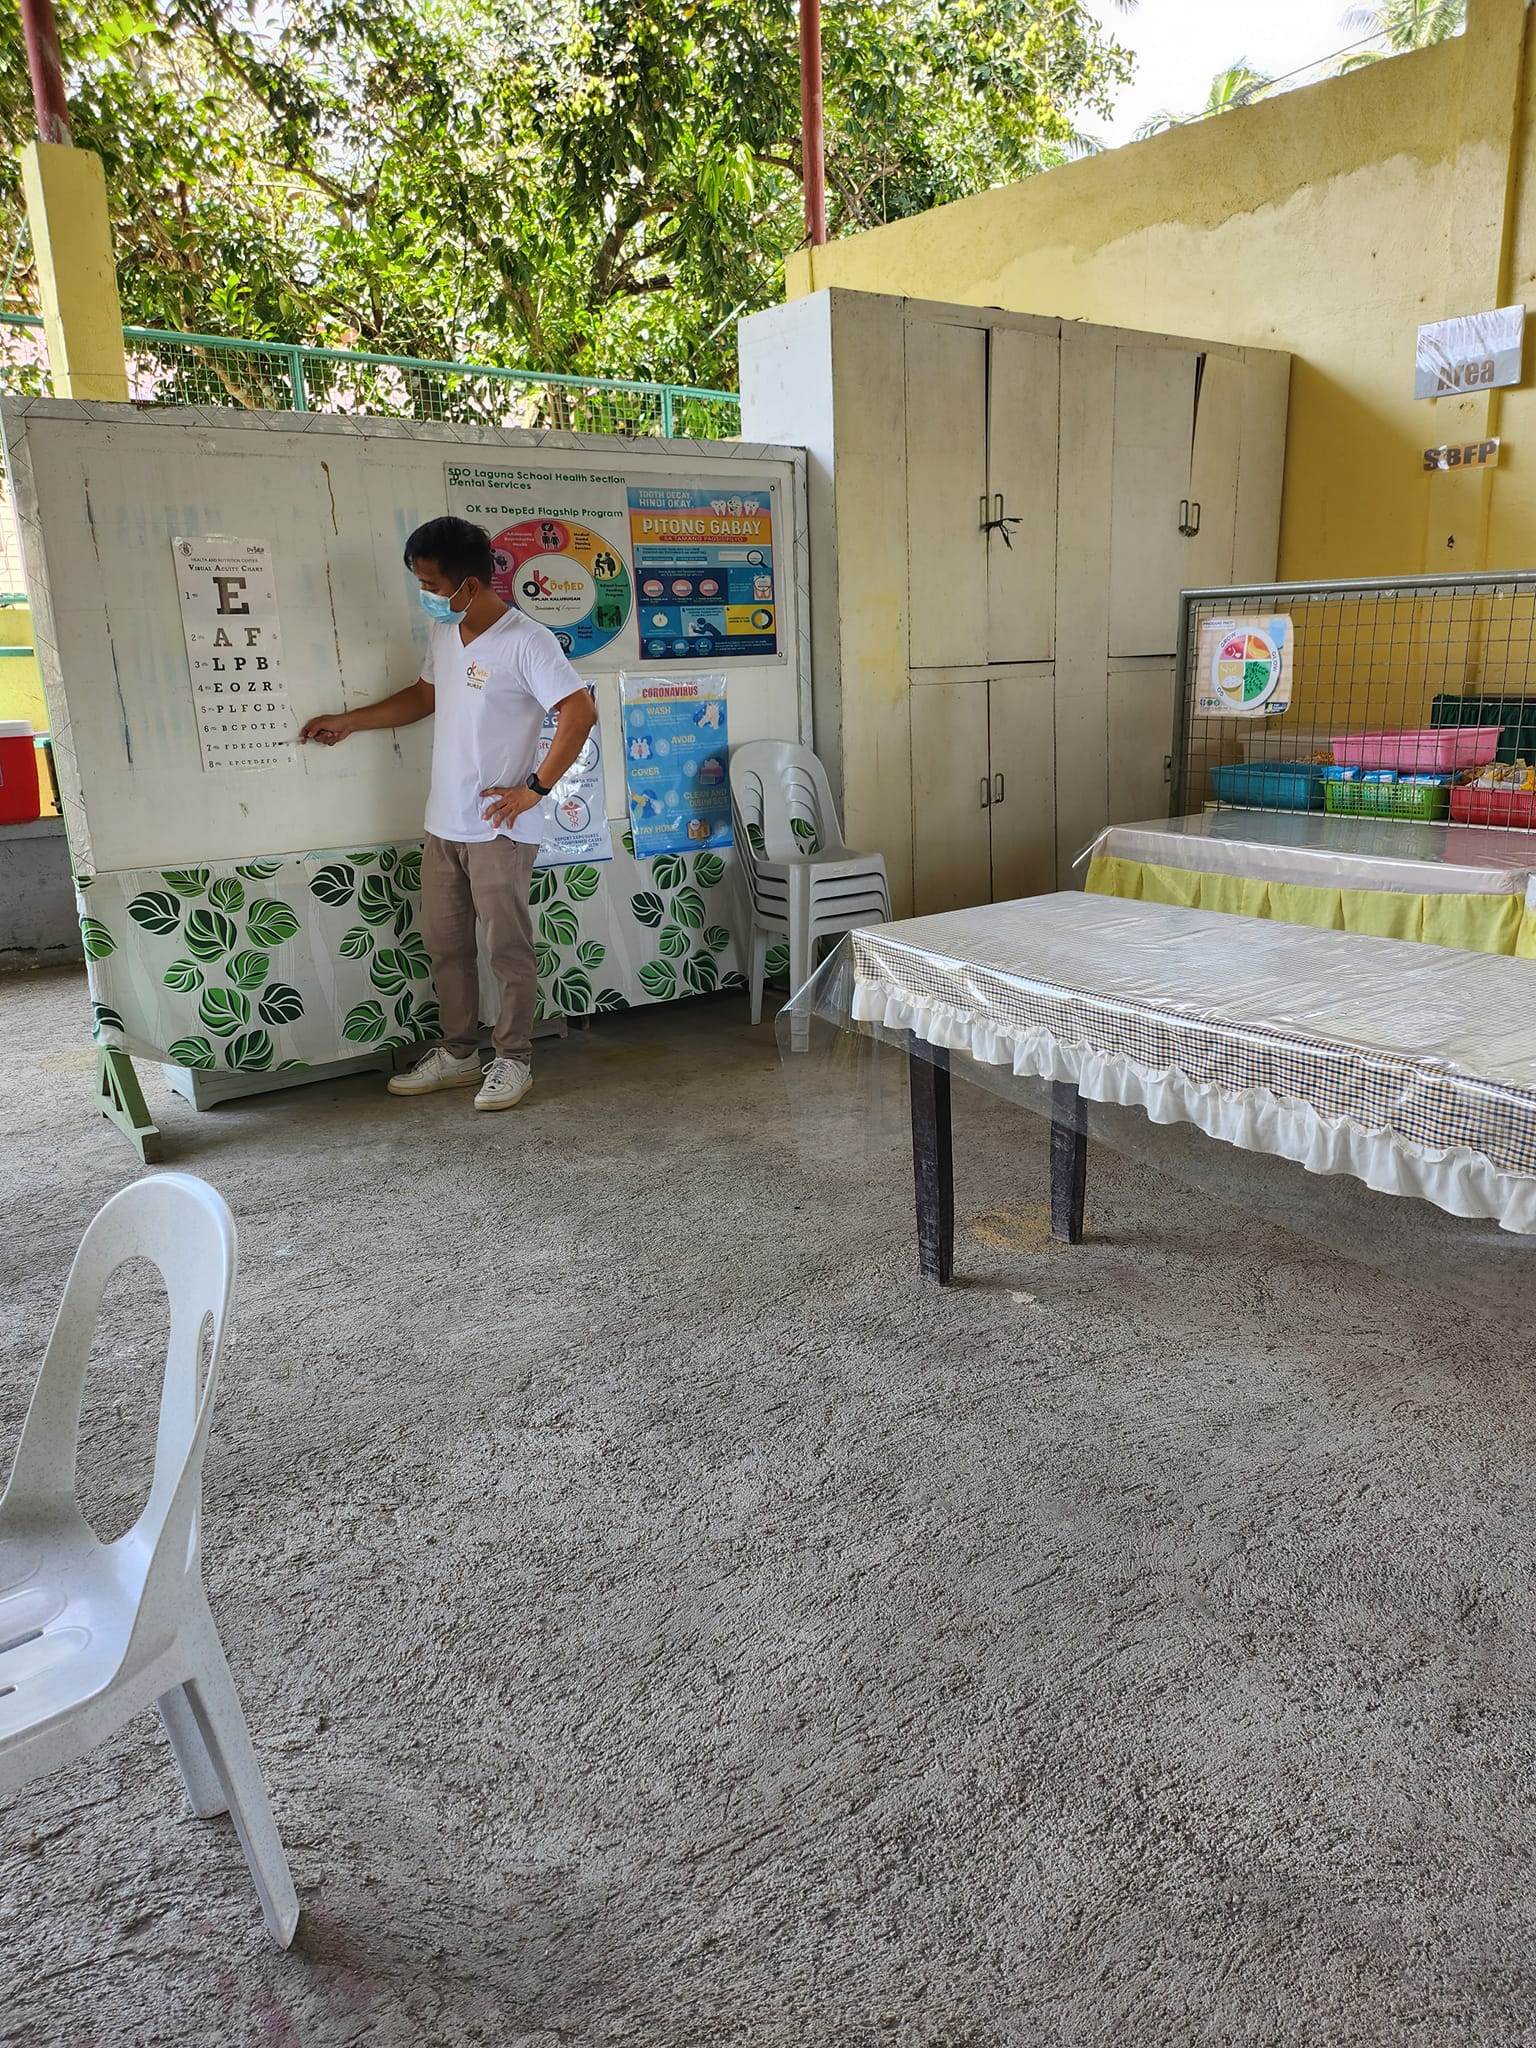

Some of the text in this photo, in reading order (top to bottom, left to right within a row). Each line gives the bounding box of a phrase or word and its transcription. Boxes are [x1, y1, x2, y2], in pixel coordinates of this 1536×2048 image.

[1437, 359, 1495, 391] Area
[1424, 441, 1498, 472] SBFP
[448, 468, 626, 484] SDO Laguna School Health Section
[449, 478, 532, 490] Dental Services
[639, 491, 665, 499] TOOTH
[639, 499, 666, 508] HINDI
[465, 504, 482, 513] OK
[501, 505, 535, 516] DepEd
[538, 507, 579, 517] Flagship
[582, 508, 623, 518] Program
[643, 518, 761, 535] PITONG GABAY
[212, 577, 250, 615] E
[642, 686, 698, 698] CORONAVIRUS
[646, 706, 671, 715] WASH
[671, 734, 695, 743] AVOID
[631, 768, 660, 777] COVER
